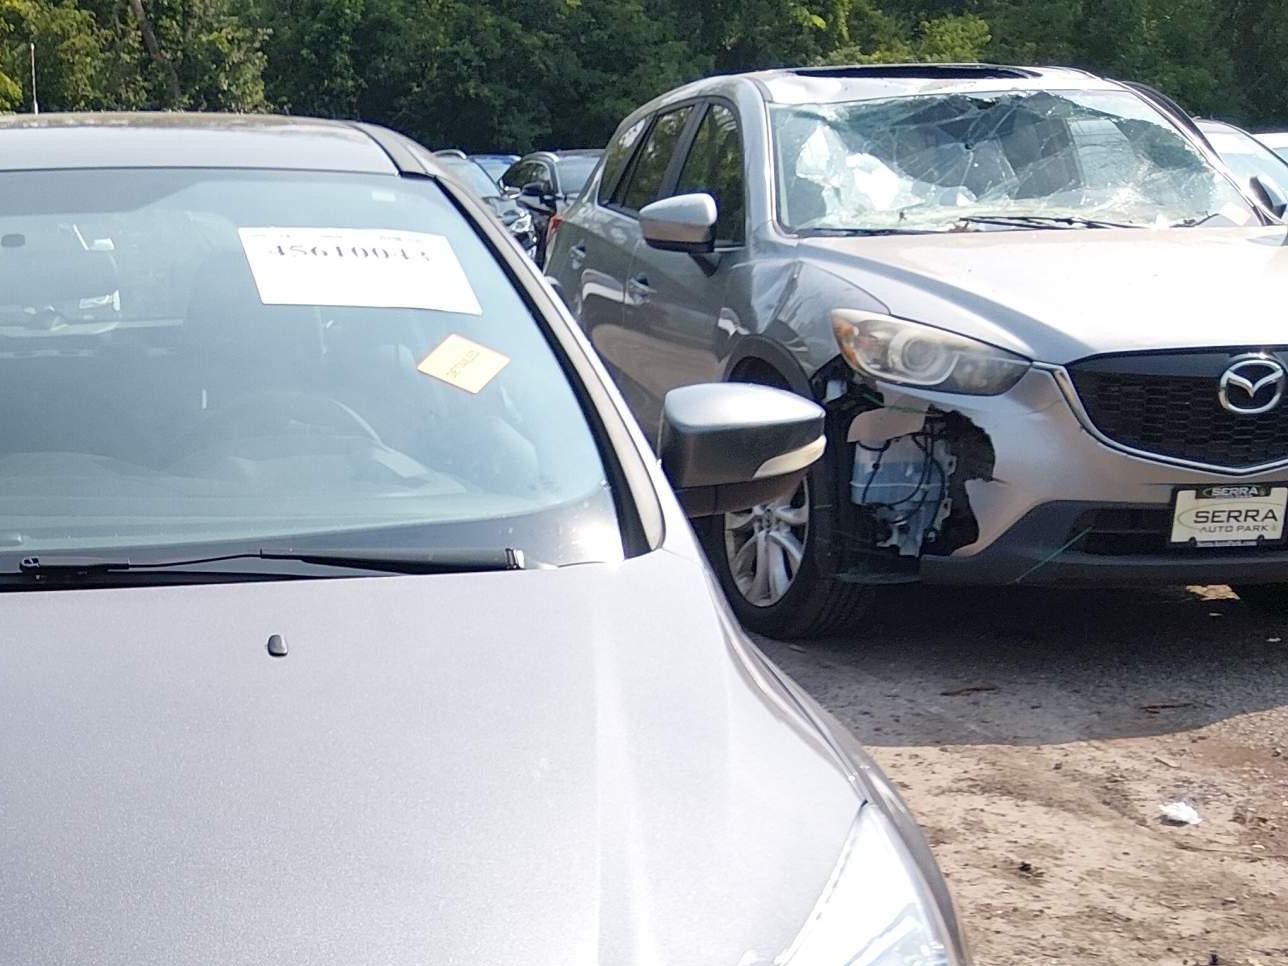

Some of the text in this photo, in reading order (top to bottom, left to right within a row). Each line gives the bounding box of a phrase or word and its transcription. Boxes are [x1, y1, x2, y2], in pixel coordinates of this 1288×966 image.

[1212, 487, 1259, 496] SERRA
[1193, 510, 1278, 523] SERRA
[1199, 524, 1269, 534] AUTO PARK
